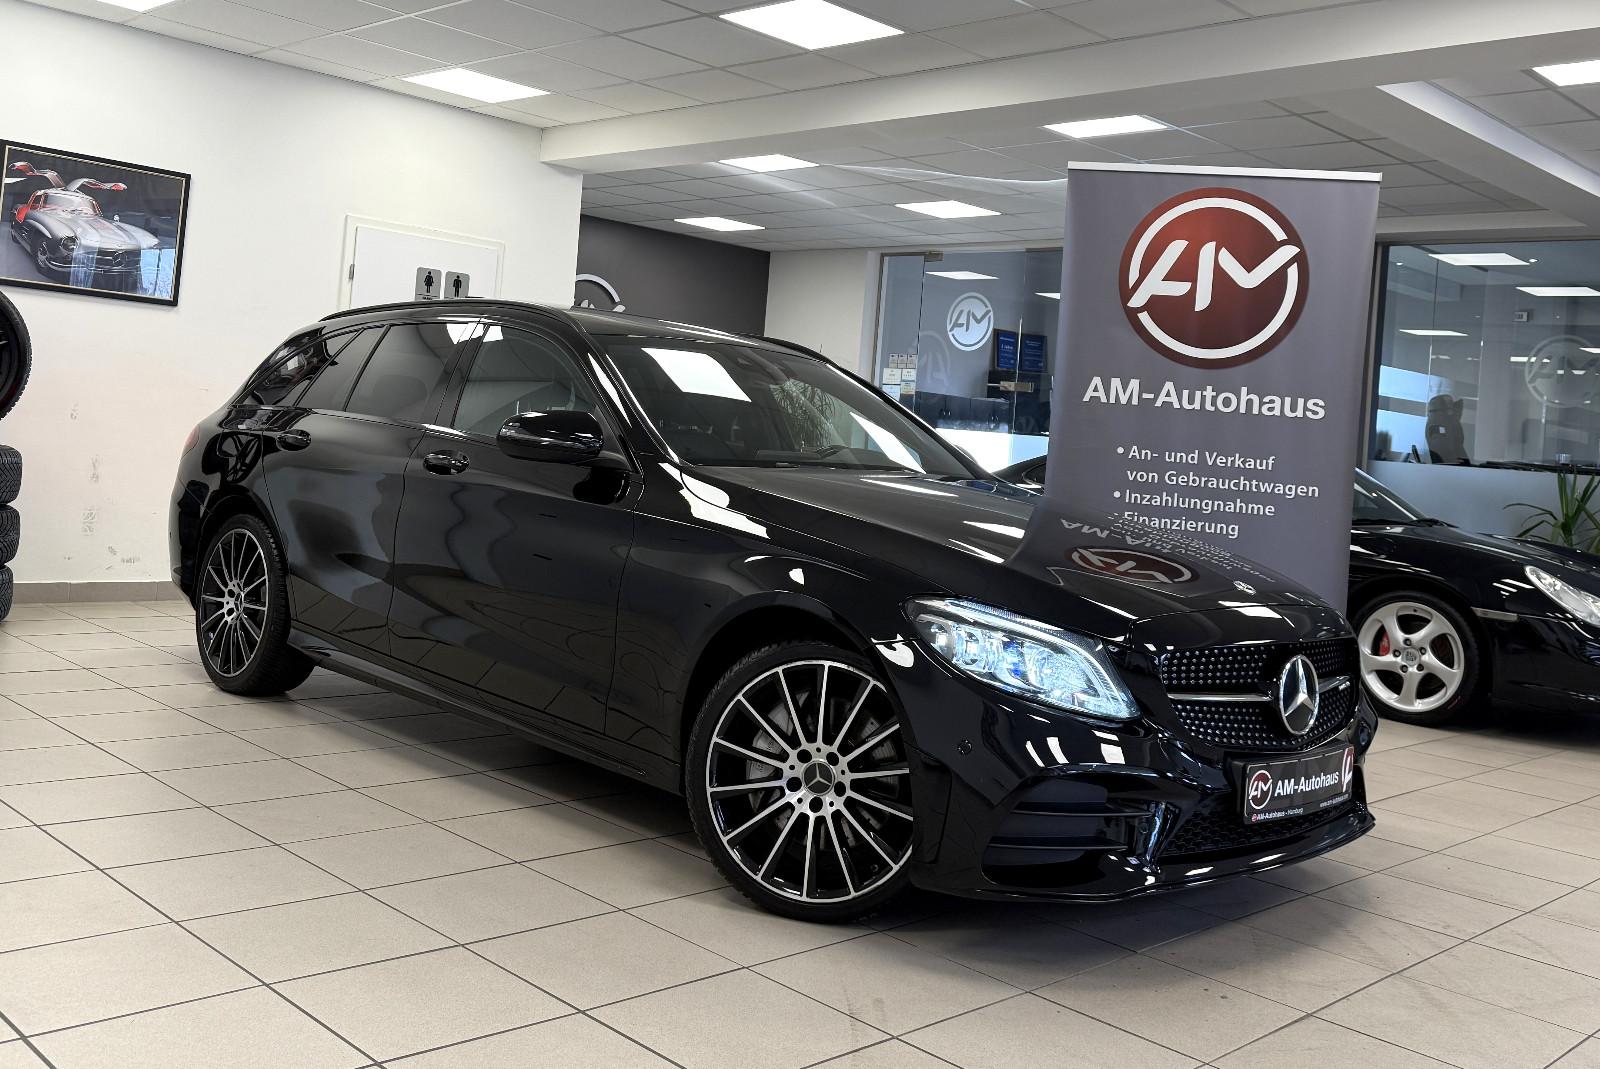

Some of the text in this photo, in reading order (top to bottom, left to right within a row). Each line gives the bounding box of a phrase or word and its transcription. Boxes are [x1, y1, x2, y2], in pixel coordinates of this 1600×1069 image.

[1126, 239, 1301, 312] AM
[1082, 376, 1326, 420] AM-Autohaus
[1127, 445, 1276, 471] An- und Verkauf
[1126, 470, 1320, 499] von Gebrauchtwagen
[1124, 489, 1276, 516] Inzahlungnahme
[1123, 511, 1240, 539] Finanzierung
[1274, 771, 1339, 797] AM-Autohaus
